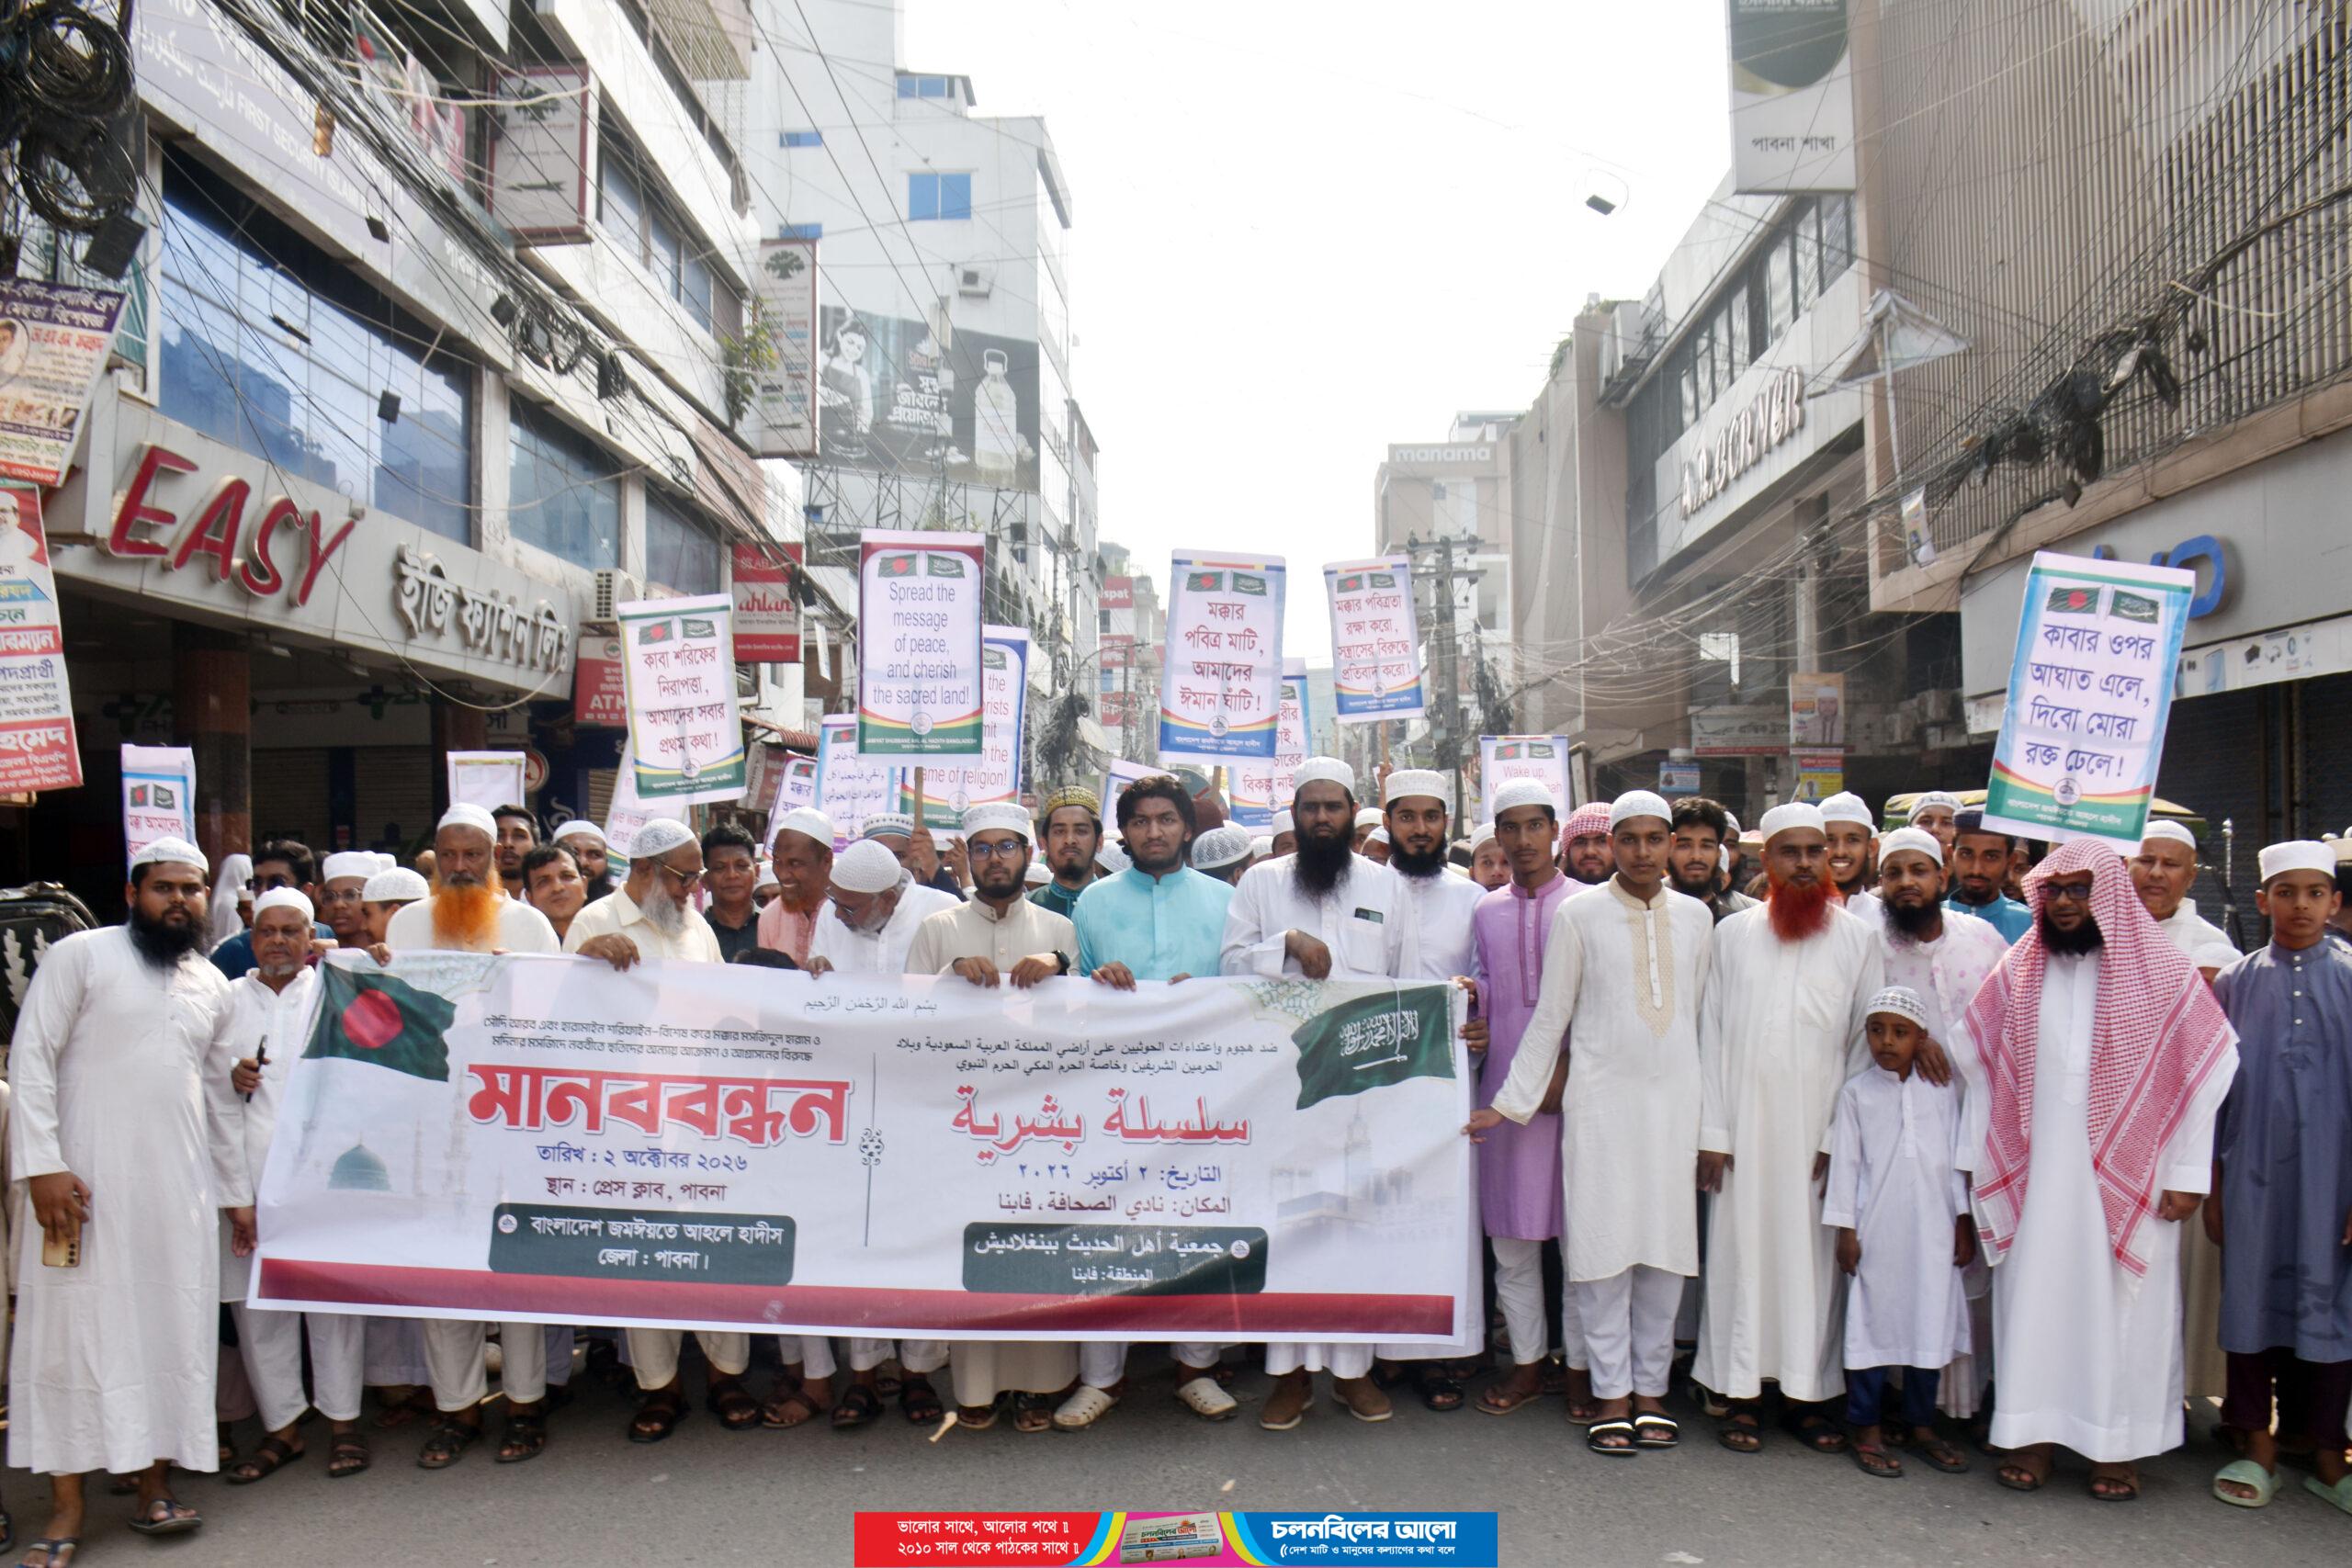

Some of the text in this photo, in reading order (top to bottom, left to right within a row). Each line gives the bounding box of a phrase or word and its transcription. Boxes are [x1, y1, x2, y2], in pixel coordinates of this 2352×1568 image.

[237, 92, 272, 136] FIRST
[273, 122, 323, 181] SECURITY
[1752, 136, 1836, 152] পাবনা শাখা
[1395, 447, 1491, 462] manama
[99, 442, 360, 608] EASY
[396, 542, 459, 639] ইজি
[459, 589, 534, 664] ফ্যাশন
[889, 581, 956, 603] Spread the
[1335, 592, 1402, 614] মক্কার পবিত্রতা
[893, 610, 948, 632] message
[1206, 601, 1247, 621] মক্কার
[1185, 624, 1223, 649] পবিত্র
[1345, 620, 1366, 636] রক্ষা
[895, 636, 950, 658] of peace,
[1377, 637, 1410, 657] বিরুদ্ধে
[2043, 623, 2156, 661] কাবার ওপর
[643, 643, 718, 670] কাবা শরিফের
[888, 660, 956, 680] and cherish
[1192, 660, 1253, 682] আমাদের
[1341, 662, 1378, 682] প্রতিবাদ
[988, 673, 1006, 692] the
[2029, 661, 2150, 708] আঘাত এলে,
[874, 684, 969, 705] the sacred land!
[1179, 686, 1218, 712] ঈমান
[645, 702, 726, 728] আমাদের সবার
[2029, 694, 2138, 741] দিবো মোরা
[659, 738, 686, 756] প্রথম
[991, 744, 1008, 763] the
[2025, 741, 2061, 765] রক্ত
[922, 766, 1007, 790] ame of religion!
[1503, 764, 1530, 778] Wake
[1242, 774, 1272, 794] বিকল্প
[483, 1015, 507, 1028] সৌদি
[509, 1019, 537, 1030] আরব
[538, 1021, 560, 1031] এবং
[561, 1021, 606, 1033] হারামাইন
[690, 1028, 711, 1040] করে
[712, 1030, 740, 1042] মক্কার
[741, 1030, 784, 1046] মসজিদুল
[785, 1034, 811, 1045] হারাম
[813, 1036, 822, 1046] ও
[492, 1032, 526, 1048] মদিনার
[527, 1034, 566, 1049] মসজিদে
[568, 1036, 605, 1052] নববীতে
[646, 1044, 678, 1055] অন্যায়
[680, 1045, 719, 1058] আক্রমণ
[721, 1048, 729, 1058] ও
[730, 1047, 780, 1061] আগ্রাসনের
[781, 1047, 814, 1063] বিরুদ্ধে
[925, 1036, 972, 1053] السعودية
[976, 1037, 1011, 1056] العربية
[1014, 1039, 1053, 1053] المملكة
[1057, 1039, 1090, 1058] أراضي
[1093, 1041, 1115, 1056] على
[1121, 1041, 1165, 1055] الحوثيين
[1170, 1041, 1222, 1055] واعتداءات
[1227, 1043, 1254, 1057] هجوم
[1260, 1041, 1278, 1054] ضد
[956, 1057, 1223, 1077] الحرمين الشريفين وخاصة الحرم المكي الحرم النبوي
[467, 1063, 854, 1147] মানববন্ধন
[950, 1084, 1251, 1160] سلسلة بشرية
[536, 1141, 749, 1172] তারিখ ২ অক্টোবর ২০২৬
[1019, 1164, 1070, 1179] ٢٠٢٦
[1082, 1159, 1129, 1187] أكتوبر
[1139, 1166, 1148, 1180] ٢
[544, 1176, 574, 1197] স্থান
[593, 1179, 626, 1199] প্রেস
[679, 1183, 728, 1201] পাবনা
[998, 1191, 1033, 1211] فابنا
[1125, 1196, 1164, 1221] نادي
[530, 1214, 784, 1246] বাংলাদেশ জমঈয়তে আহলে হাদীস
[1065, 1233, 1125, 1257] الحديث
[1131, 1231, 1162, 1257] أهل
[1168, 1233, 1224, 1258] جمعية
[597, 1247, 639, 1268] জেলা
[1071, 1266, 1098, 1283] فابنا
